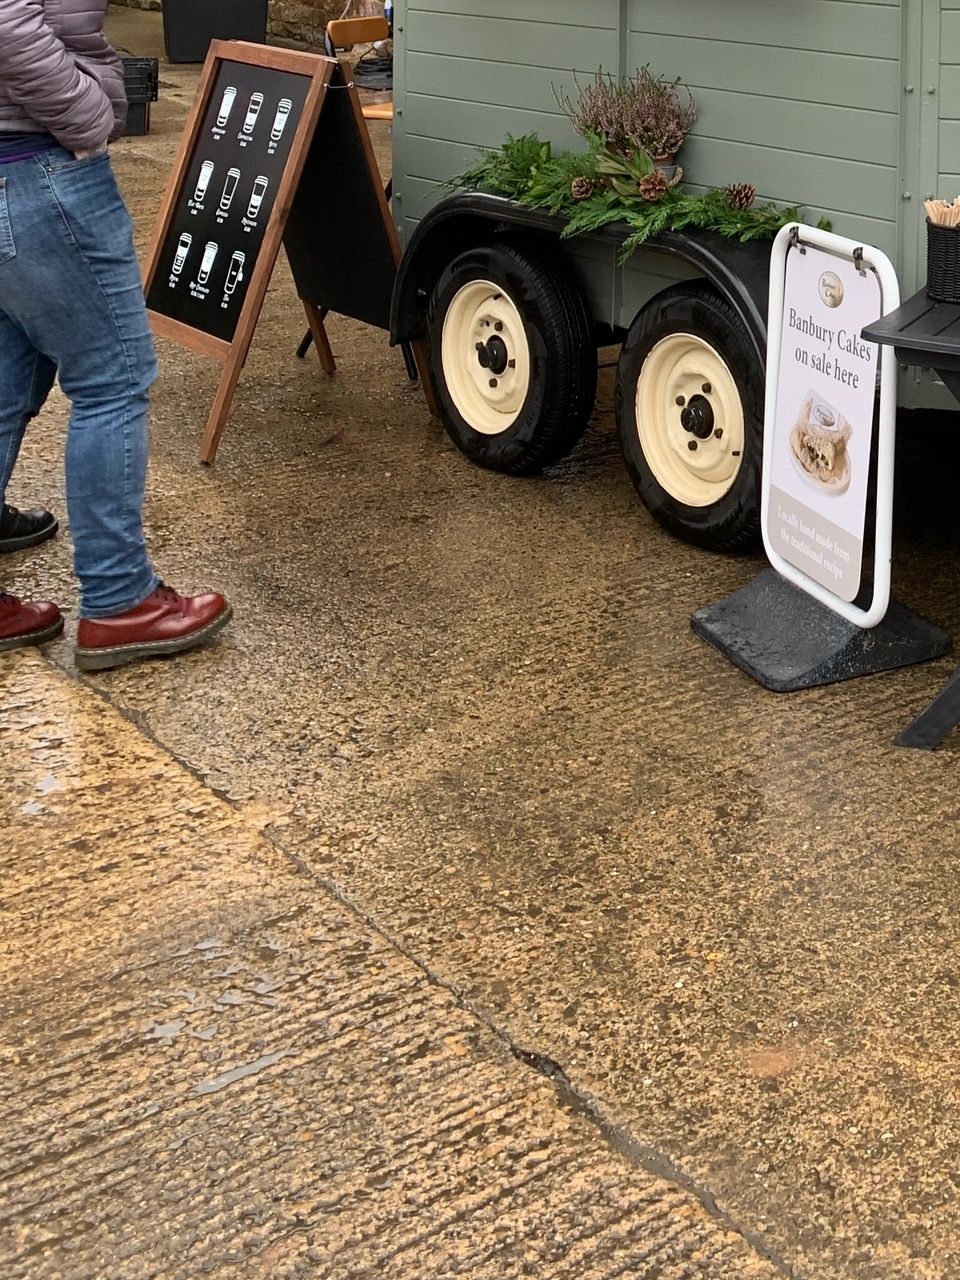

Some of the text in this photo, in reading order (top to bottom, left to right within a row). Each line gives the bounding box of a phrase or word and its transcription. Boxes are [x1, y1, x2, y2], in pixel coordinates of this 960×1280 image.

[789, 308, 871, 362] Banbury Cakes
[795, 347, 859, 389] on sale here
[799, 520, 816, 540] hand
[790, 535, 823, 565] traditional
[823, 559, 843, 579] recipe
